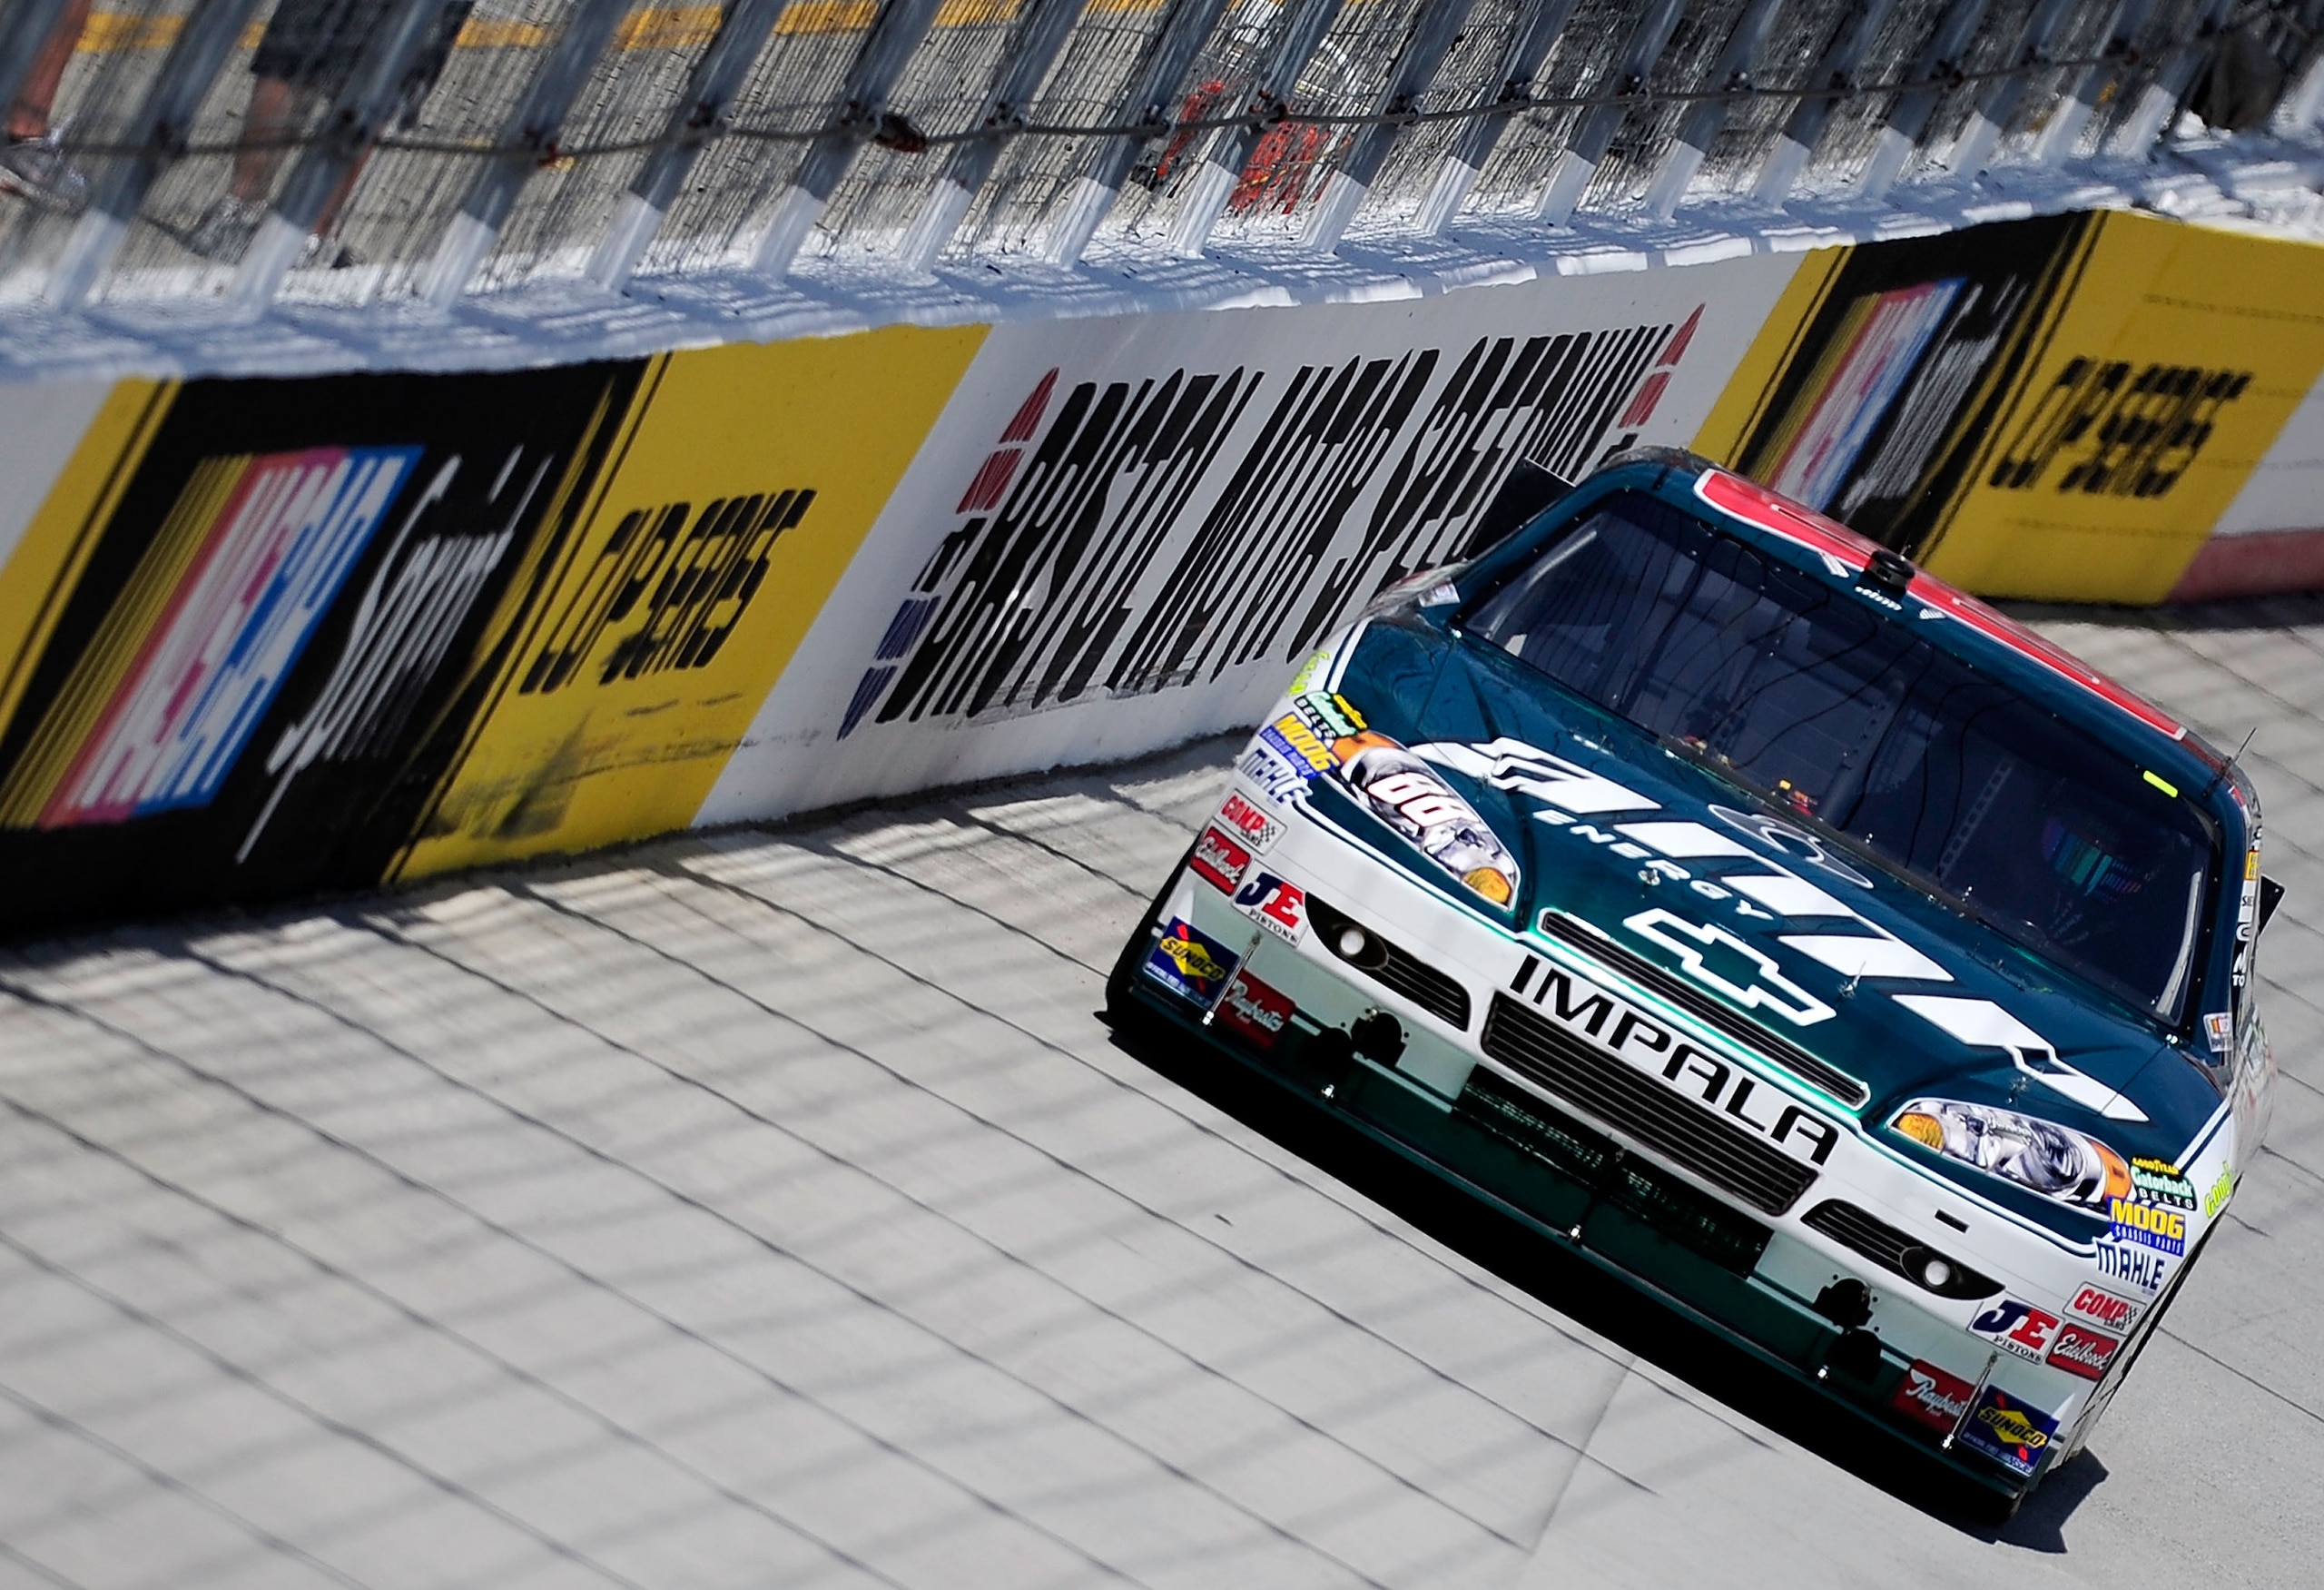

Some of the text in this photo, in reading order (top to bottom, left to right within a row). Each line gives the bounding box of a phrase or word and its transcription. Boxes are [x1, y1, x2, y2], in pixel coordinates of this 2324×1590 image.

[875, 366, 1265, 725] BRISTOL
[1105, 350, 1440, 693] MOTOR
[518, 501, 692, 696] CUP
[598, 489, 817, 686] SERIES
[1275, 714, 1340, 772] MOOG
[1532, 809, 1774, 920] ENERGY
[1236, 872, 1305, 929] JE
[1248, 909, 1298, 943] PISTONS
[1163, 939, 1225, 980] SUNOCO
[1510, 953, 1839, 1167] IMPALA
[2111, 1199, 2186, 1240] MOOG
[2139, 1188, 2194, 1210] BELTS
[2096, 1239, 2165, 1290] MAHLE
[1972, 1299, 2060, 1350] JE
[2073, 1289, 2129, 1320] COMP
[1993, 1335, 2043, 1362] PISTONS
[1979, 1407, 2046, 1447] SUNOCO
